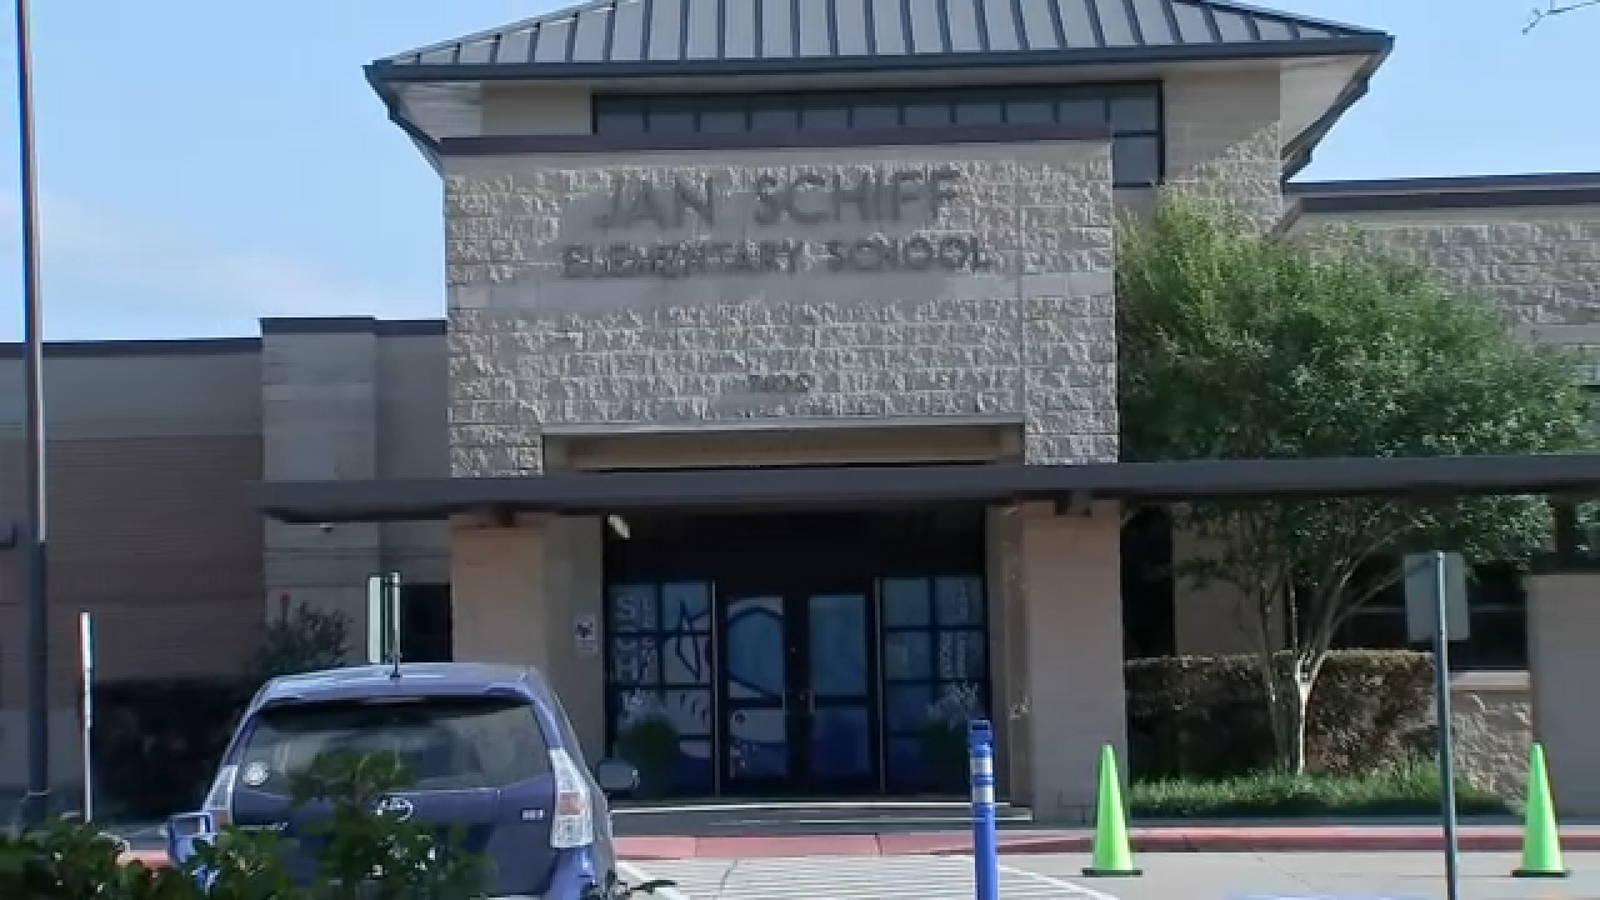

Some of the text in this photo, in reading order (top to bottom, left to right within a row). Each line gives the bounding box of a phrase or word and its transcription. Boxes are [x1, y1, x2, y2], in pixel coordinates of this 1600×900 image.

[593, 167, 961, 228] JAN SCHIFF
[563, 235, 992, 278] ELEMENTARY SCHOOL
